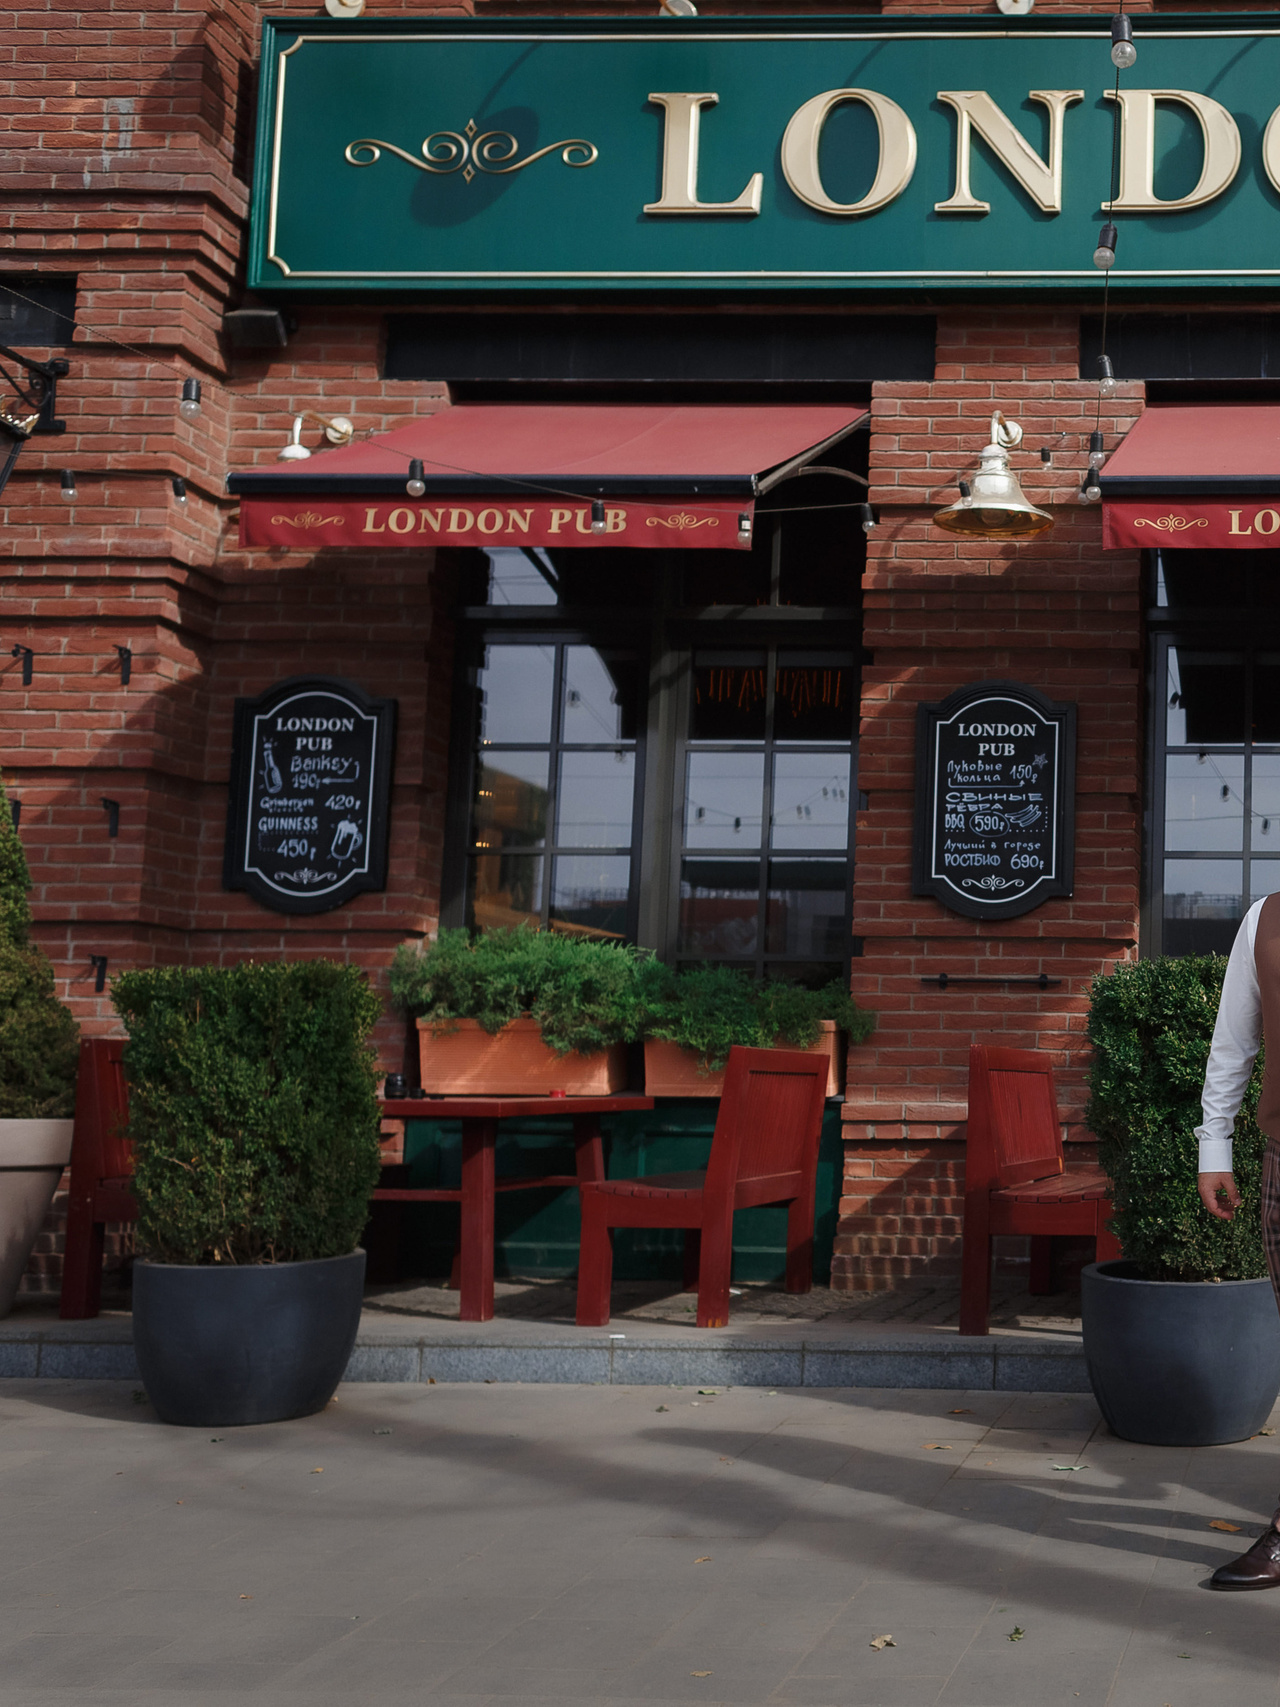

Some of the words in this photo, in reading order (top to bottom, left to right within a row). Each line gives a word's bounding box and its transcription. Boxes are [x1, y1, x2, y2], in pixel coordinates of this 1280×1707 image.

[362, 508, 534, 535] LONDON
[548, 508, 627, 534] PUB
[276, 717, 355, 732] LONDON
[957, 722, 1037, 737] LONDON
[296, 737, 333, 751] PUB
[977, 742, 1016, 757] PUB
[945, 791, 1044, 802] СВИНЫЕ
[258, 816, 318, 833] GUINNESS
[945, 813, 966, 829] BBQ
[944, 853, 1001, 867] РОСТБИФ
